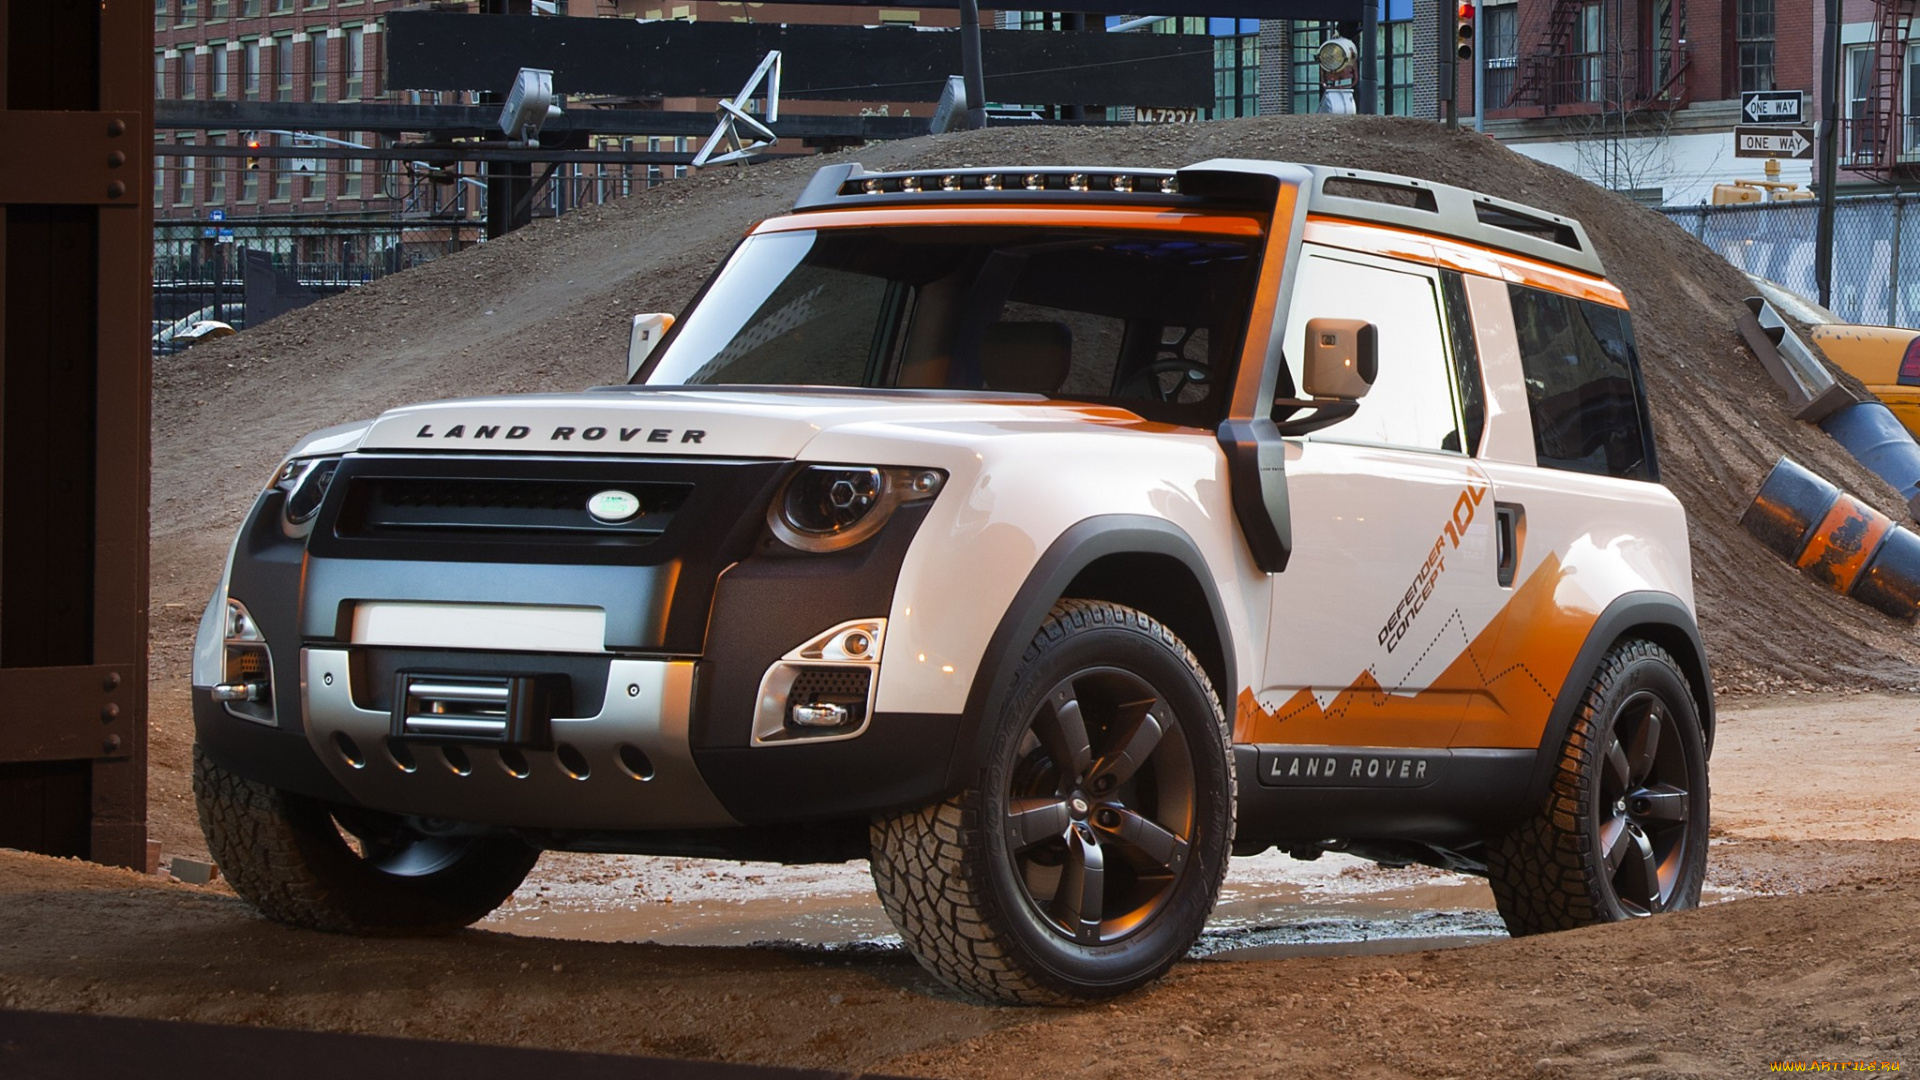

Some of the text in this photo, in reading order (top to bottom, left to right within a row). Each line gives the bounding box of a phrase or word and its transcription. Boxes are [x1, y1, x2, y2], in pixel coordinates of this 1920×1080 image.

[1750, 102, 1795, 114] ONE WAY
[1746, 136, 1803, 150] ONE WAY
[416, 424, 707, 444] LAND ROVER
[1377, 535, 1446, 647] DEFENDER
[1386, 556, 1446, 654] CONCEPT
[1270, 757, 1427, 779] LAND ROVER
